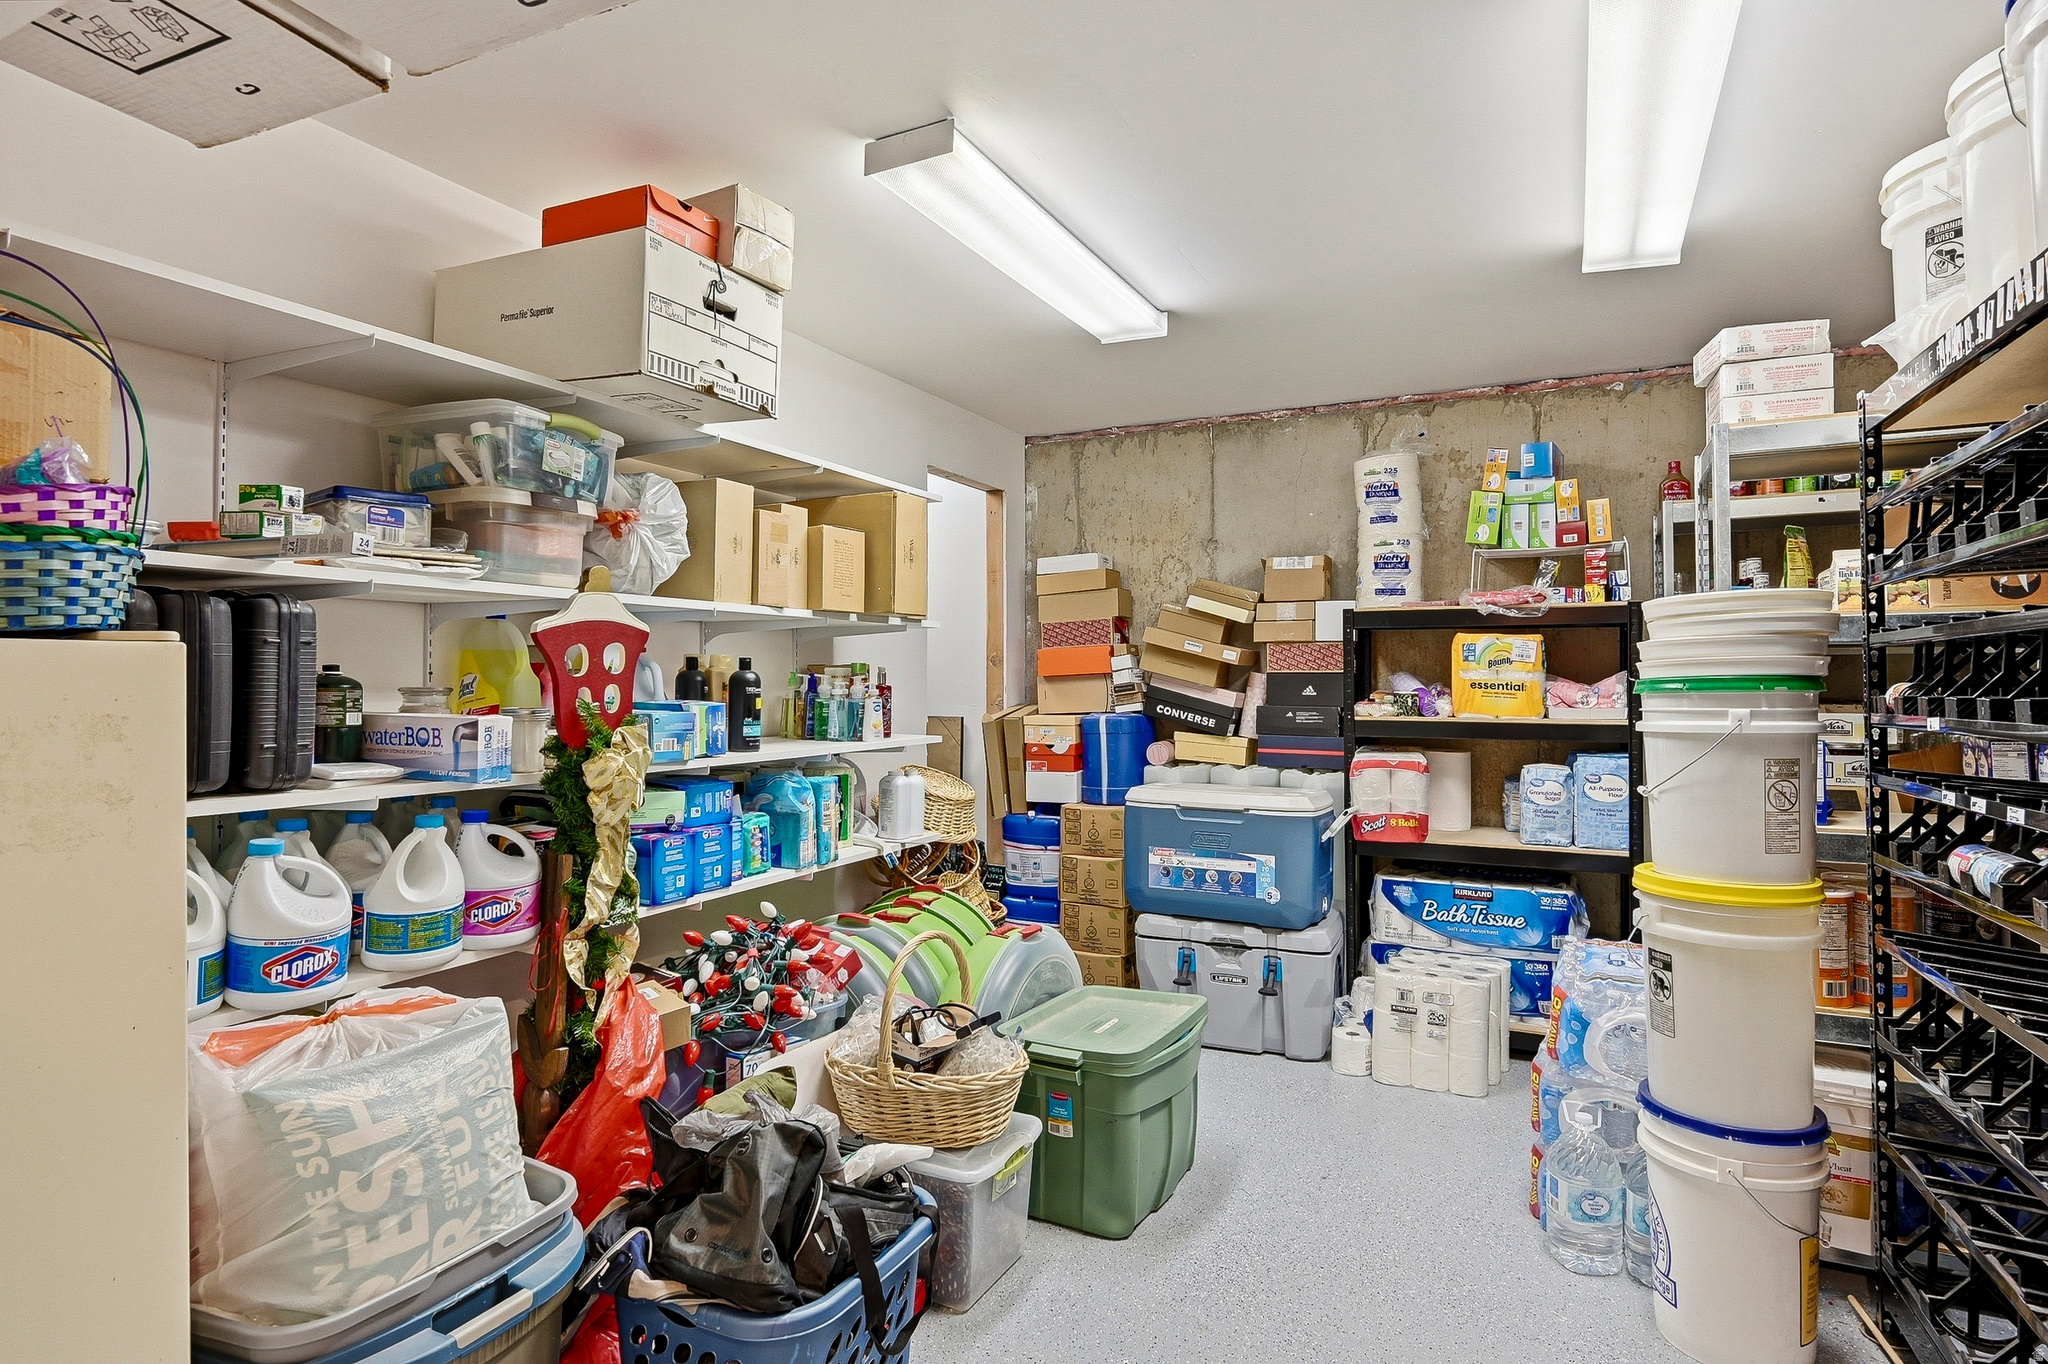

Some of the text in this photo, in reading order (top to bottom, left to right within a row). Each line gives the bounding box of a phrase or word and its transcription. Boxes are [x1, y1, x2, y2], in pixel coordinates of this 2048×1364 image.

[1934, 232, 1954, 243] AVISO
[530, 305, 554, 318] Superior
[1367, 482, 1393, 490] Hefty
[359, 538, 370, 548] 24
[1379, 554, 1406, 562] Hefty
[1156, 704, 1216, 728] CONVERSE
[1528, 789, 1561, 797] Granulated
[1361, 816, 1387, 833] Scott
[1455, 888, 1493, 898] KIRKLAND
[470, 900, 517, 923] CLOROX
[1421, 900, 1527, 929] Bath Tissue
[270, 948, 333, 984] CLOROX
[1548, 1021, 1558, 1049] VALUE
[274, 1100, 330, 1178] SUN
